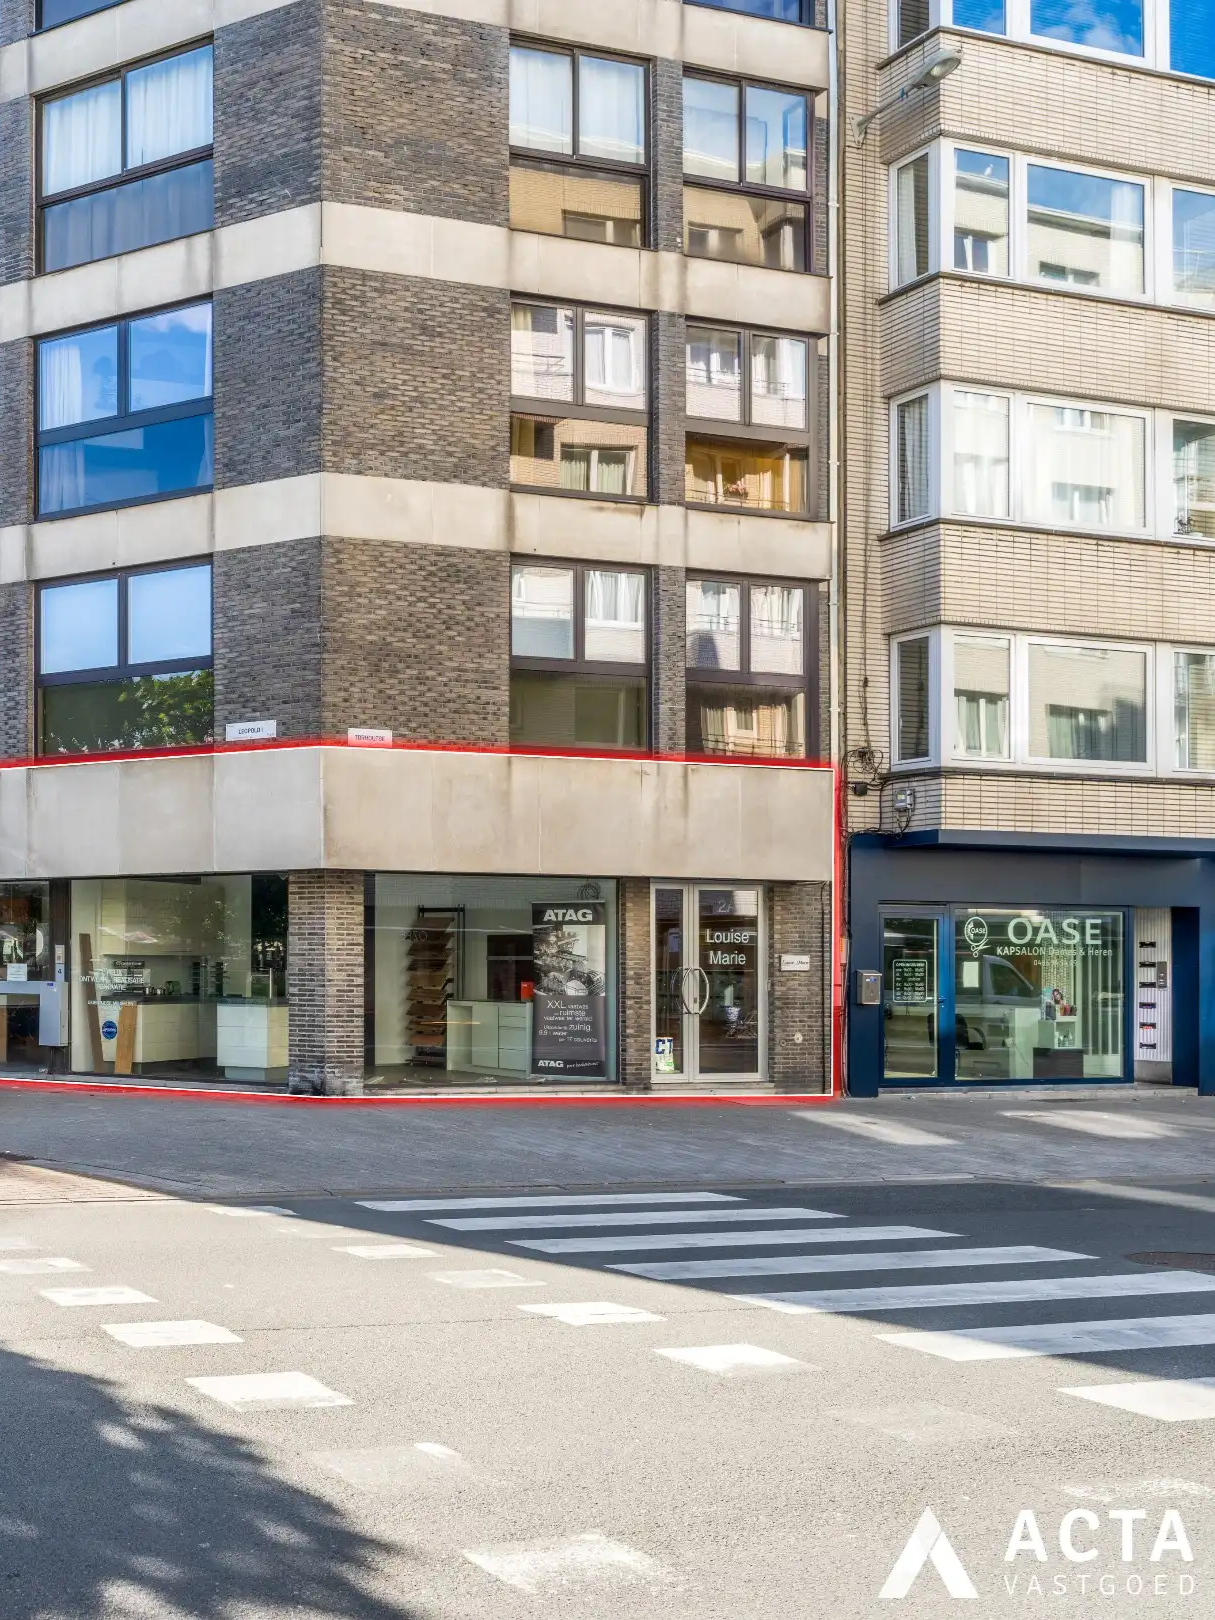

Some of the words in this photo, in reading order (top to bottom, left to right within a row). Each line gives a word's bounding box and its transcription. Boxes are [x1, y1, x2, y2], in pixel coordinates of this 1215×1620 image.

[543, 908, 593, 922] ATAG
[705, 928, 750, 944] Louise
[1007, 917, 1103, 945] OASE
[709, 950, 747, 965] Marie
[996, 946, 1046, 956] KAPSALON
[1048, 947, 1077, 956] Dames
[1087, 947, 1113, 956] Heren
[546, 999, 567, 1009] XXL
[537, 1060, 564, 1068] ATAG
